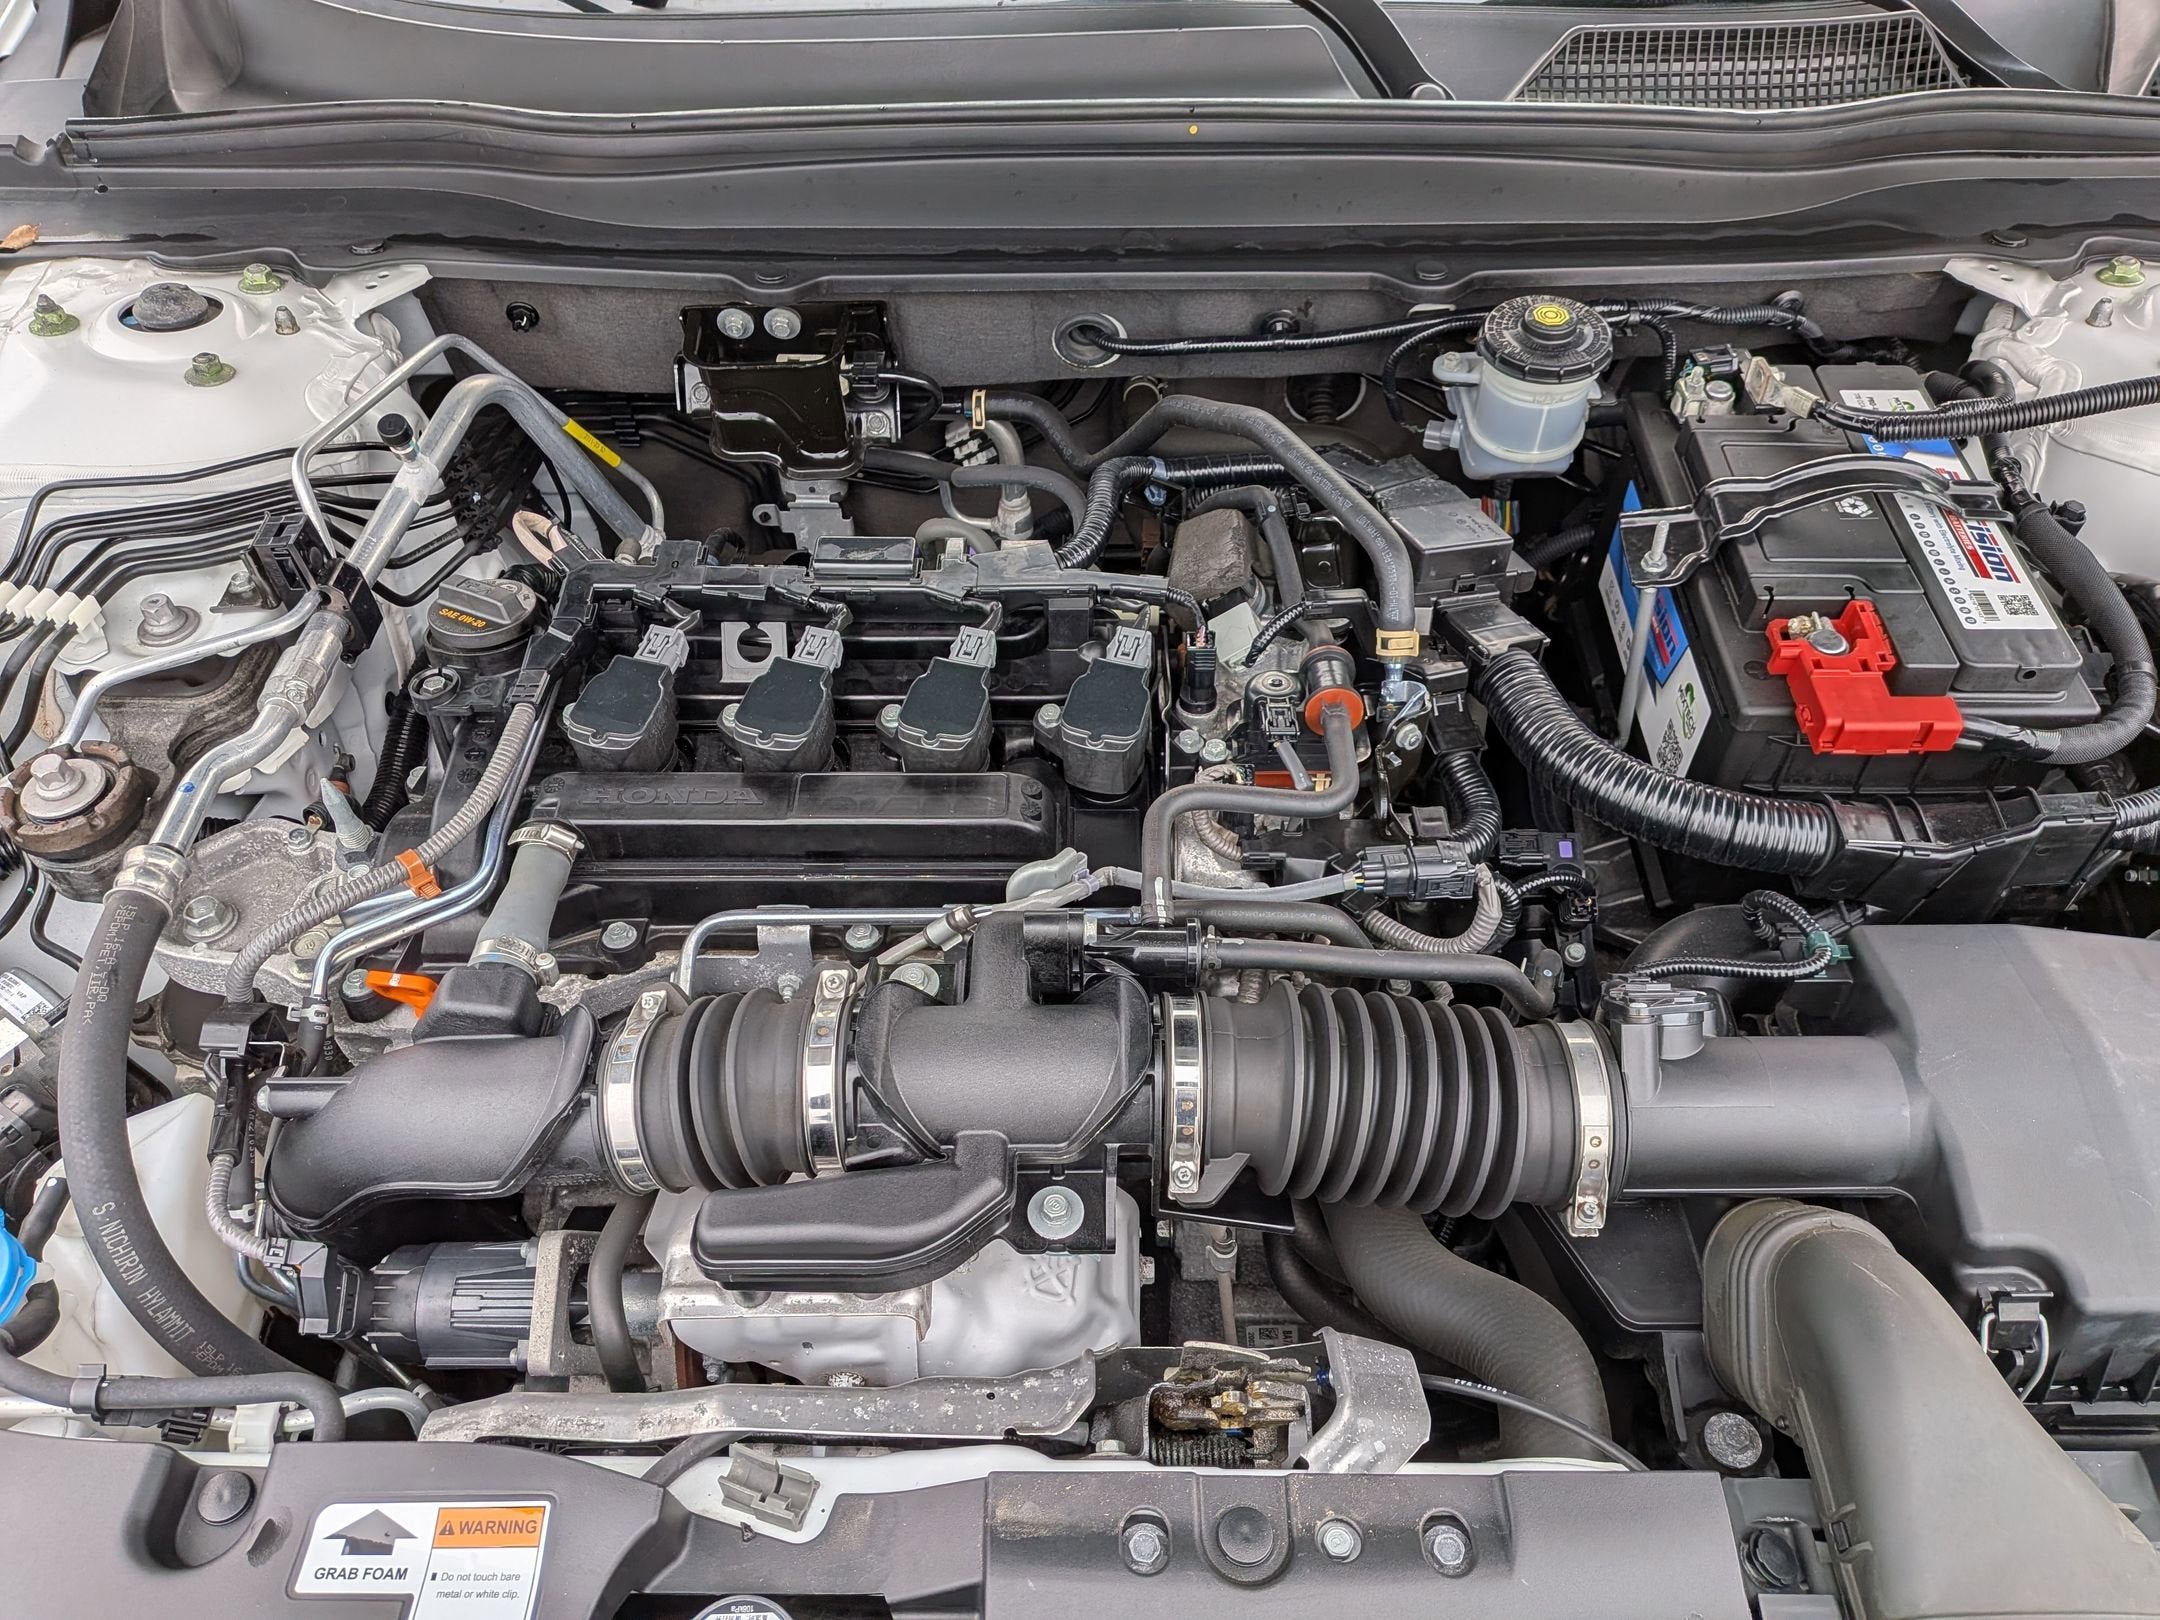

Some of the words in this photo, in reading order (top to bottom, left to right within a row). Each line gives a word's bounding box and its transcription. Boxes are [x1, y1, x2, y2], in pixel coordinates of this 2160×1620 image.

[439, 608, 460, 619] SAE
[458, 615, 486, 628] 0W-20
[583, 788, 764, 805] HONDA
[123, 905, 138, 931] 15LP
[137, 1286, 195, 1342] HYLAMMIT
[459, 1520, 537, 1534] WARNING
[314, 1567, 359, 1580] GRAB
[362, 1567, 408, 1580] FOAM
[441, 1572, 455, 1581] Do
[456, 1573, 470, 1581] not
[473, 1572, 498, 1581] touch
[500, 1572, 520, 1581] bare
[436, 1590, 461, 1598] metal
[475, 1589, 500, 1598] white
[501, 1589, 520, 1600] clip.
